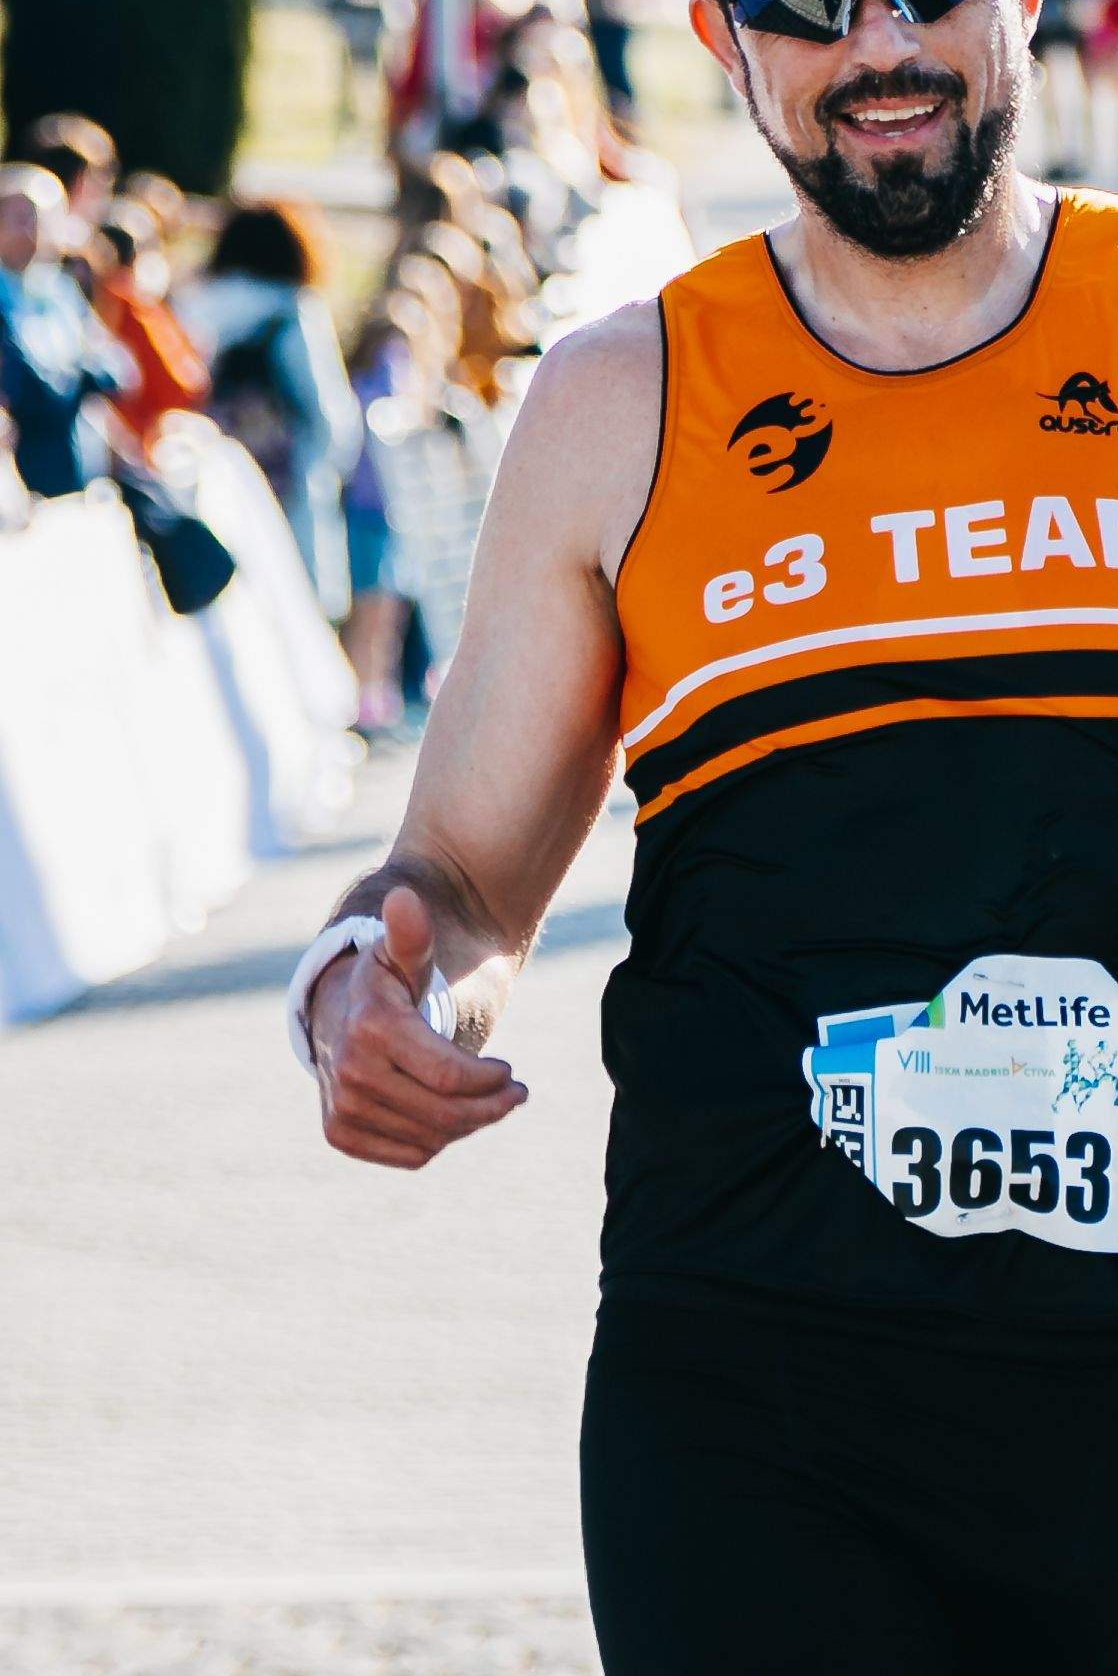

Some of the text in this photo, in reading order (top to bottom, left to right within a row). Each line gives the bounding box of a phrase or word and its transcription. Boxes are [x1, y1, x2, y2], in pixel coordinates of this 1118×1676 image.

[703, 532, 828, 624] e3
[960, 991, 1112, 1029] MetLife
[964, 1067, 1010, 1078] MADRID
[890, 1125, 1113, 1225] 3653
